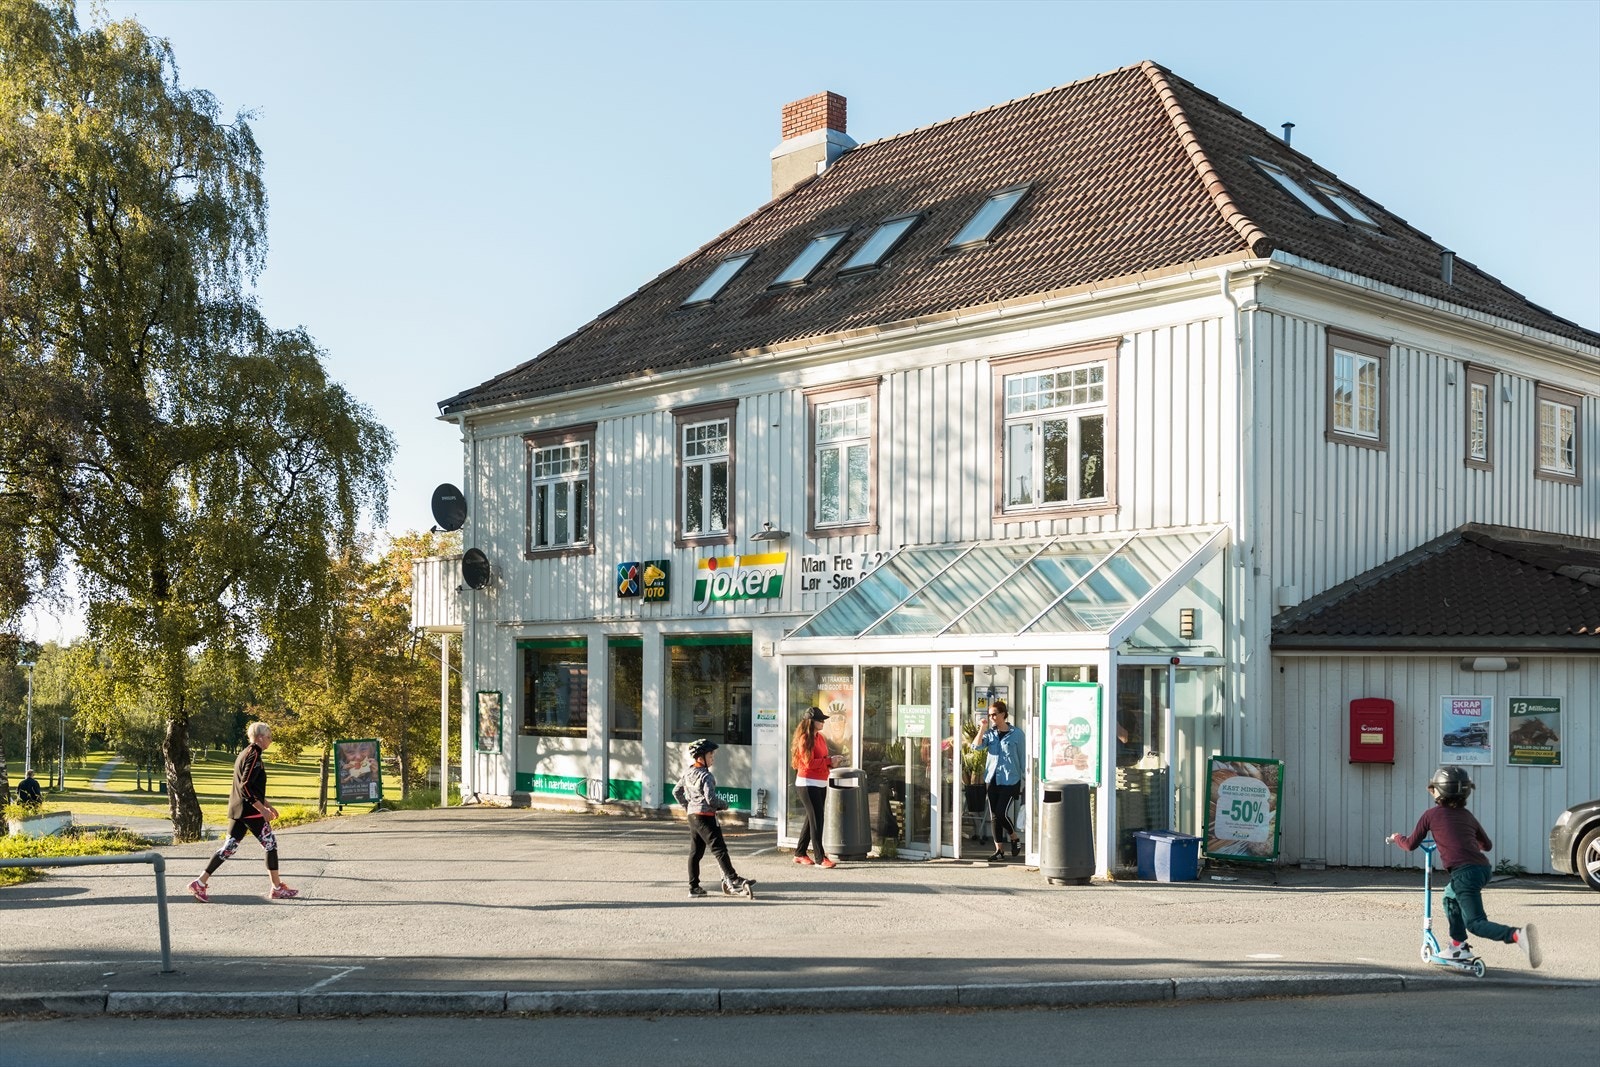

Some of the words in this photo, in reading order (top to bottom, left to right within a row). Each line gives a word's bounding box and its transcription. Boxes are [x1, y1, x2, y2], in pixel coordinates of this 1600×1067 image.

[801, 556, 826, 573] Man
[834, 555, 853, 571] Fre
[697, 555, 777, 612] joker
[801, 575, 821, 591] Lør
[644, 587, 665, 598] TOTO
[1512, 702, 1528, 714] 13
[532, 777, 544, 788] helt
[1222, 800, 1264, 824] -50%
